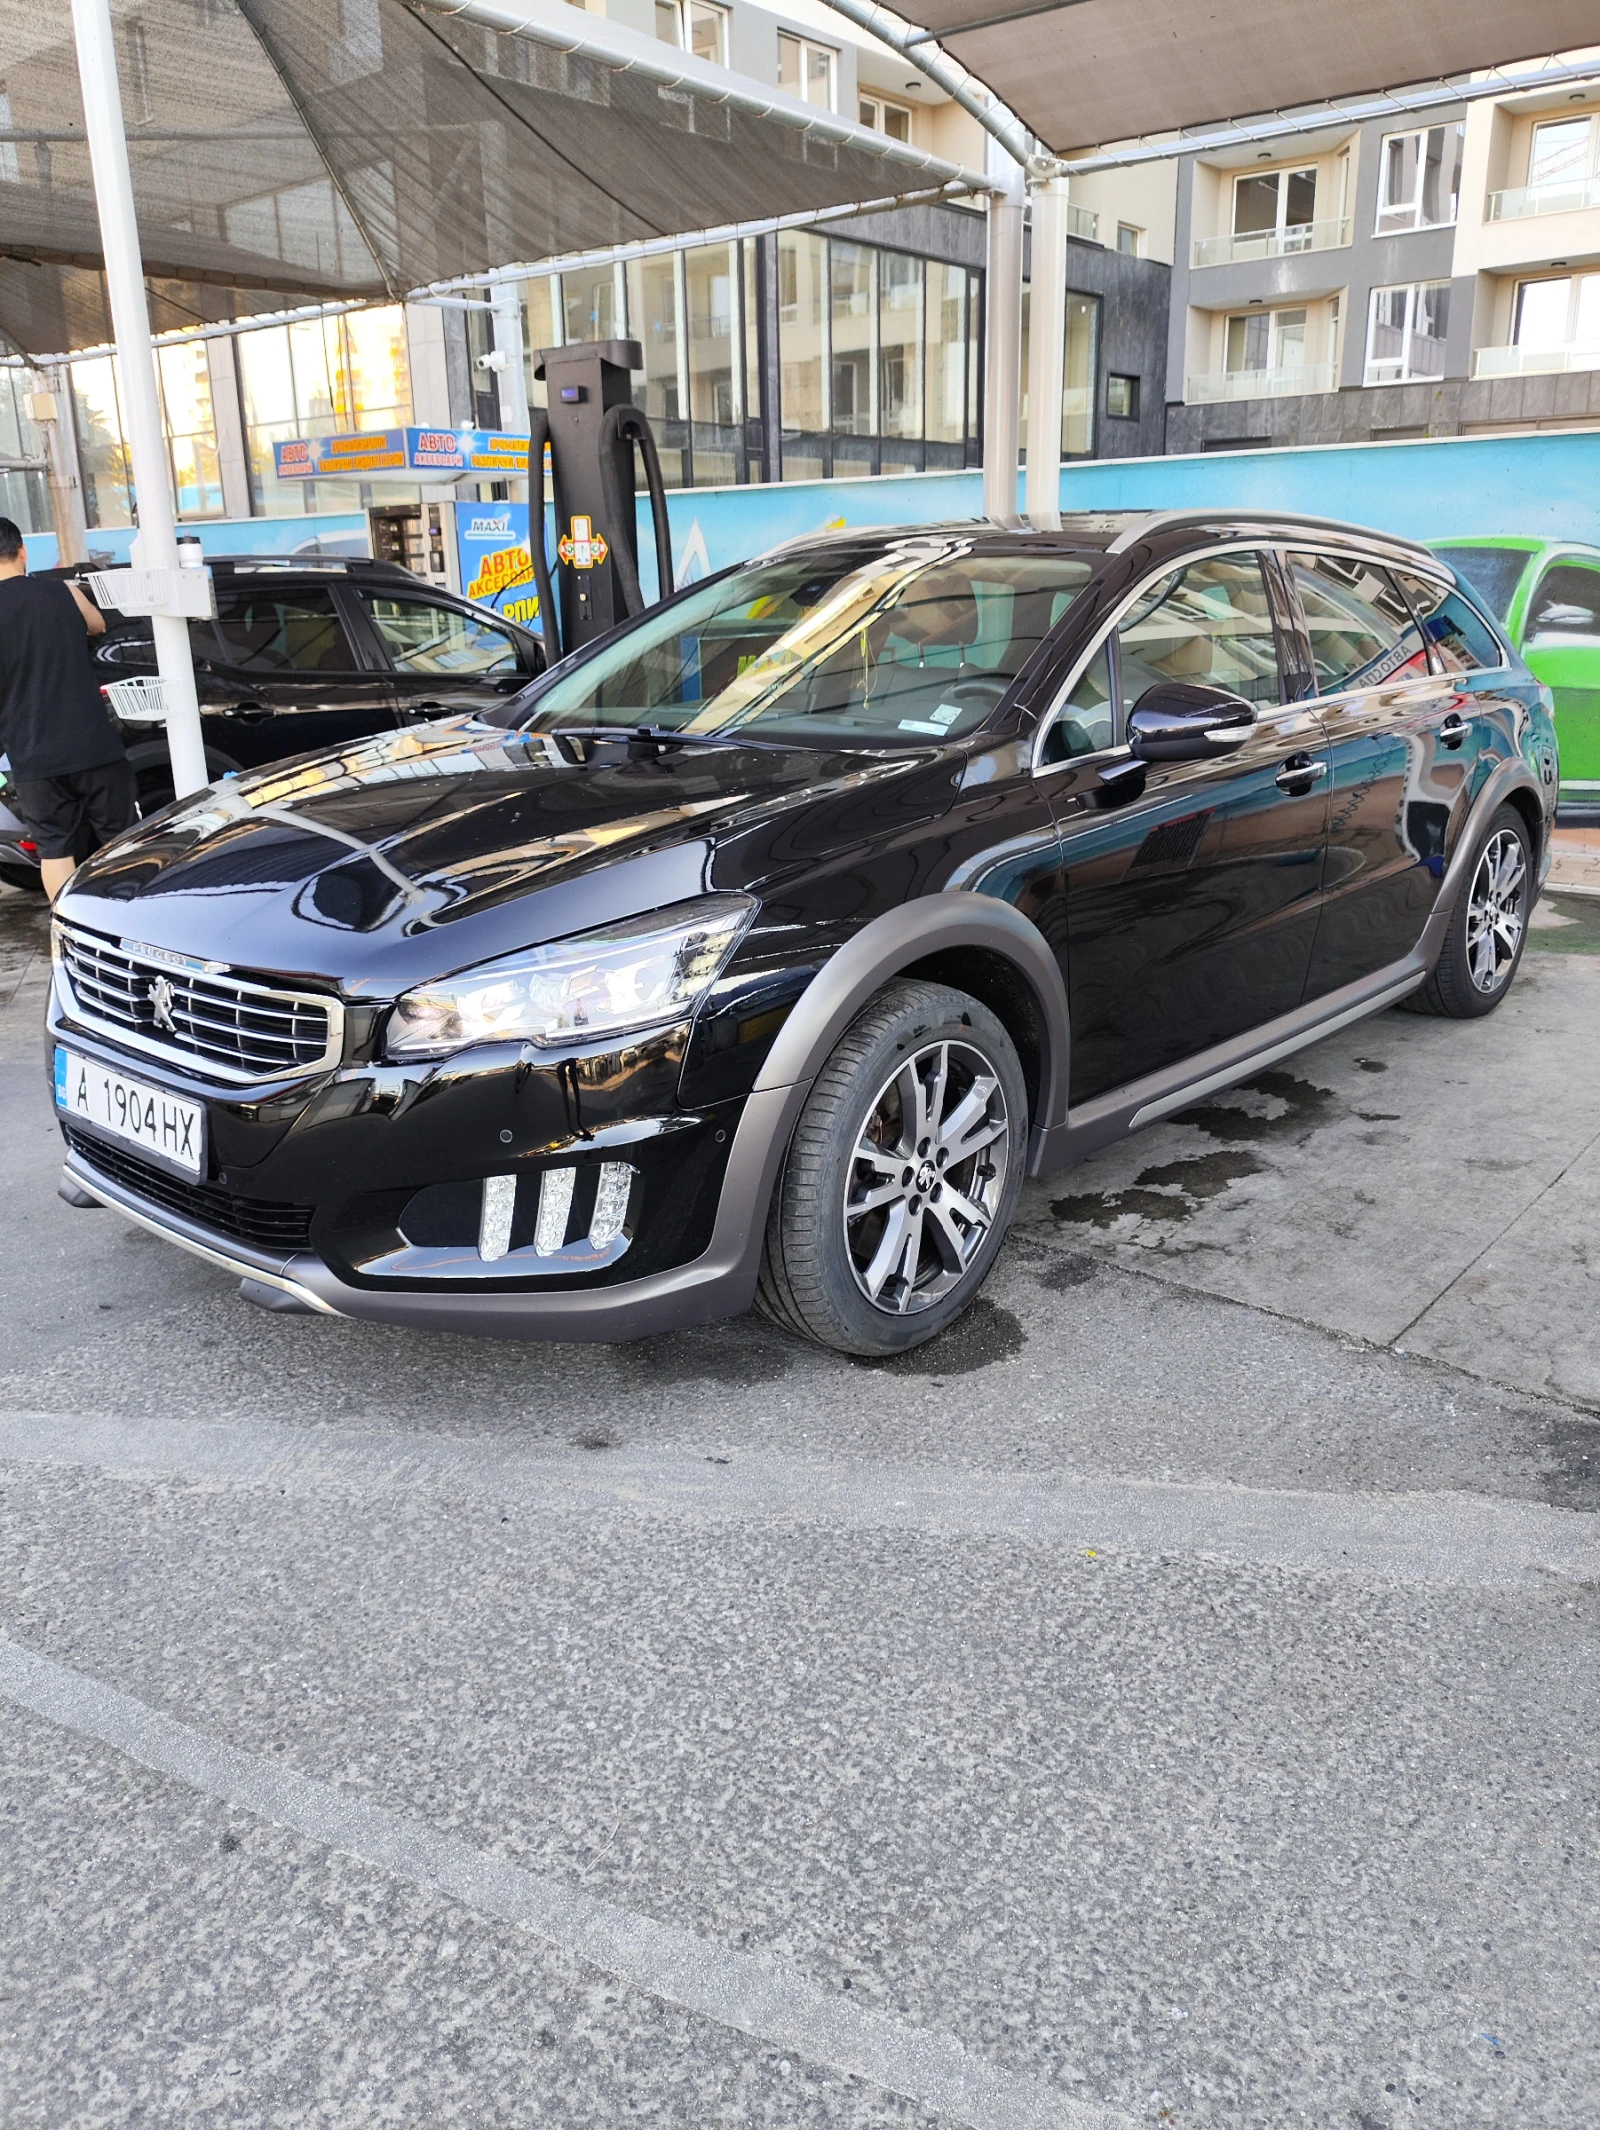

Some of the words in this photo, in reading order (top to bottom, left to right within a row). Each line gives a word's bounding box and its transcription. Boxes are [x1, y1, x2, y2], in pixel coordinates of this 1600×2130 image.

[419, 432, 456, 451] АВТО
[281, 443, 308, 463] АВТО
[414, 452, 463, 467] АКСЕСОАРИ
[472, 517, 508, 532] MAXI
[480, 547, 530, 579] АВТО
[468, 567, 535, 599] АКСЕСОАР
[503, 595, 540, 624] РПИ
